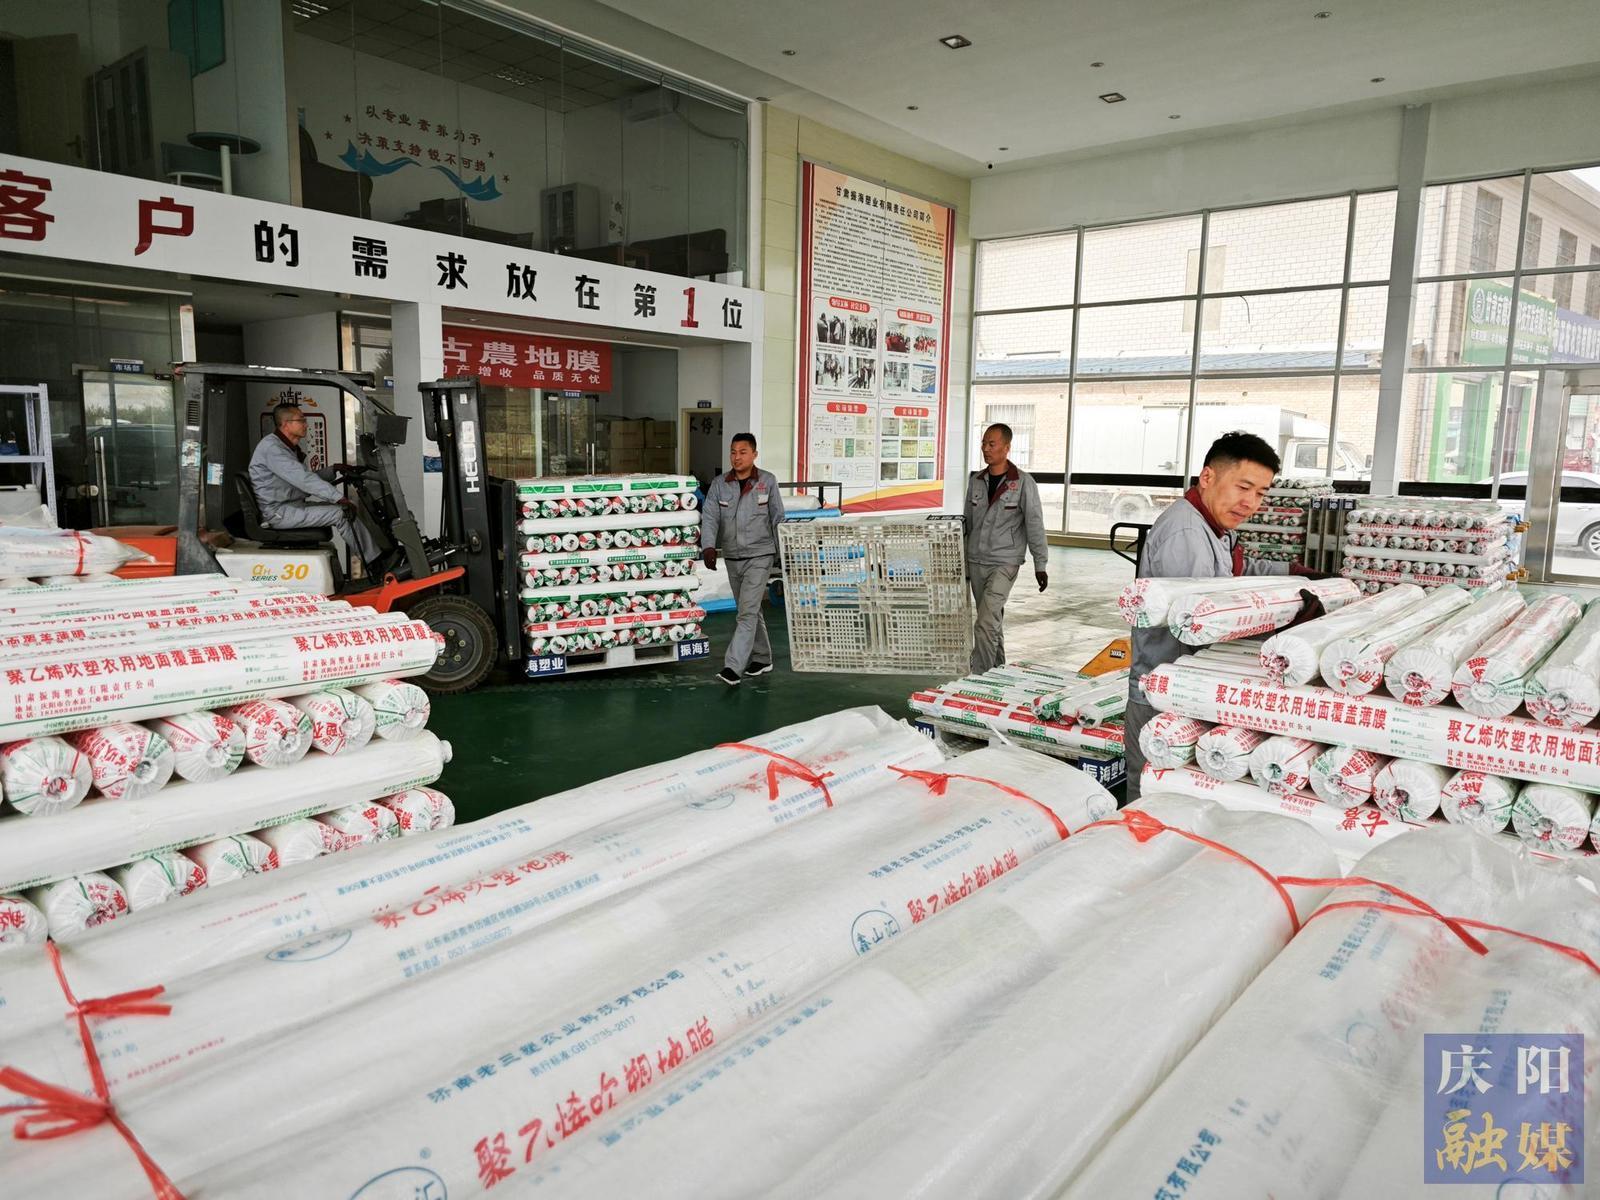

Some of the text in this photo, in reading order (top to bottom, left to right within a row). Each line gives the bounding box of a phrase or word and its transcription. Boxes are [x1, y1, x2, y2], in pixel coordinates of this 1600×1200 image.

[835, 186, 932, 224] 甘肃振海塑业有限责任公司简介
[533, 370, 601, 385] 品质无忧
[280, 563, 310, 581] 30
[6, 643, 238, 686] 聚乙烯吹塑农用地面覆盖薄膜
[14, 678, 156, 705] 甘肃振海塑业有限责任公司
[1215, 684, 1388, 730] 聚乙烯吹塑农用地面覆盖薄膜
